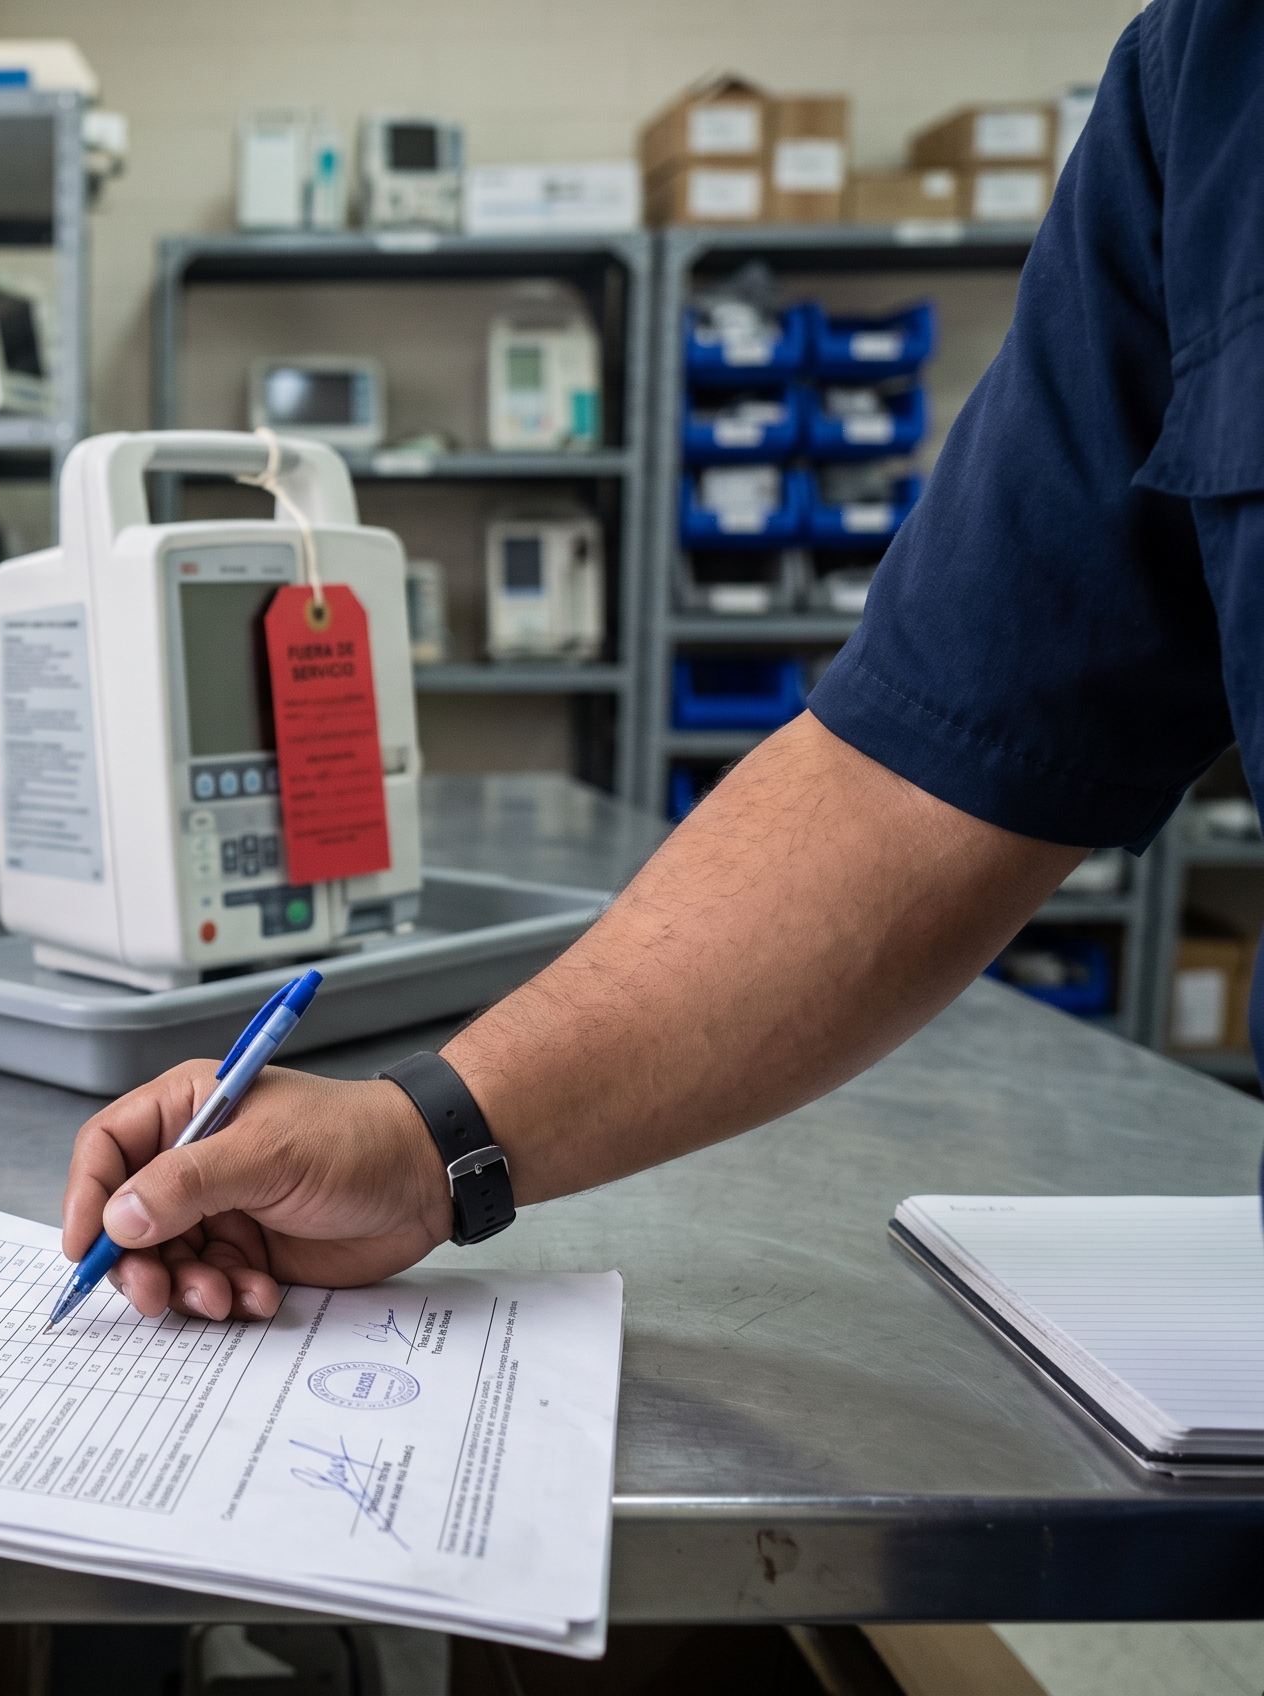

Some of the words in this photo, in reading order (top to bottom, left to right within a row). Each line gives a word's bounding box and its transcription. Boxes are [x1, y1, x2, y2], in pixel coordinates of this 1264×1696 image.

[287, 643, 332, 660] FUERA
[337, 641, 354, 657] DE
[292, 662, 355, 682] SERVICIO
